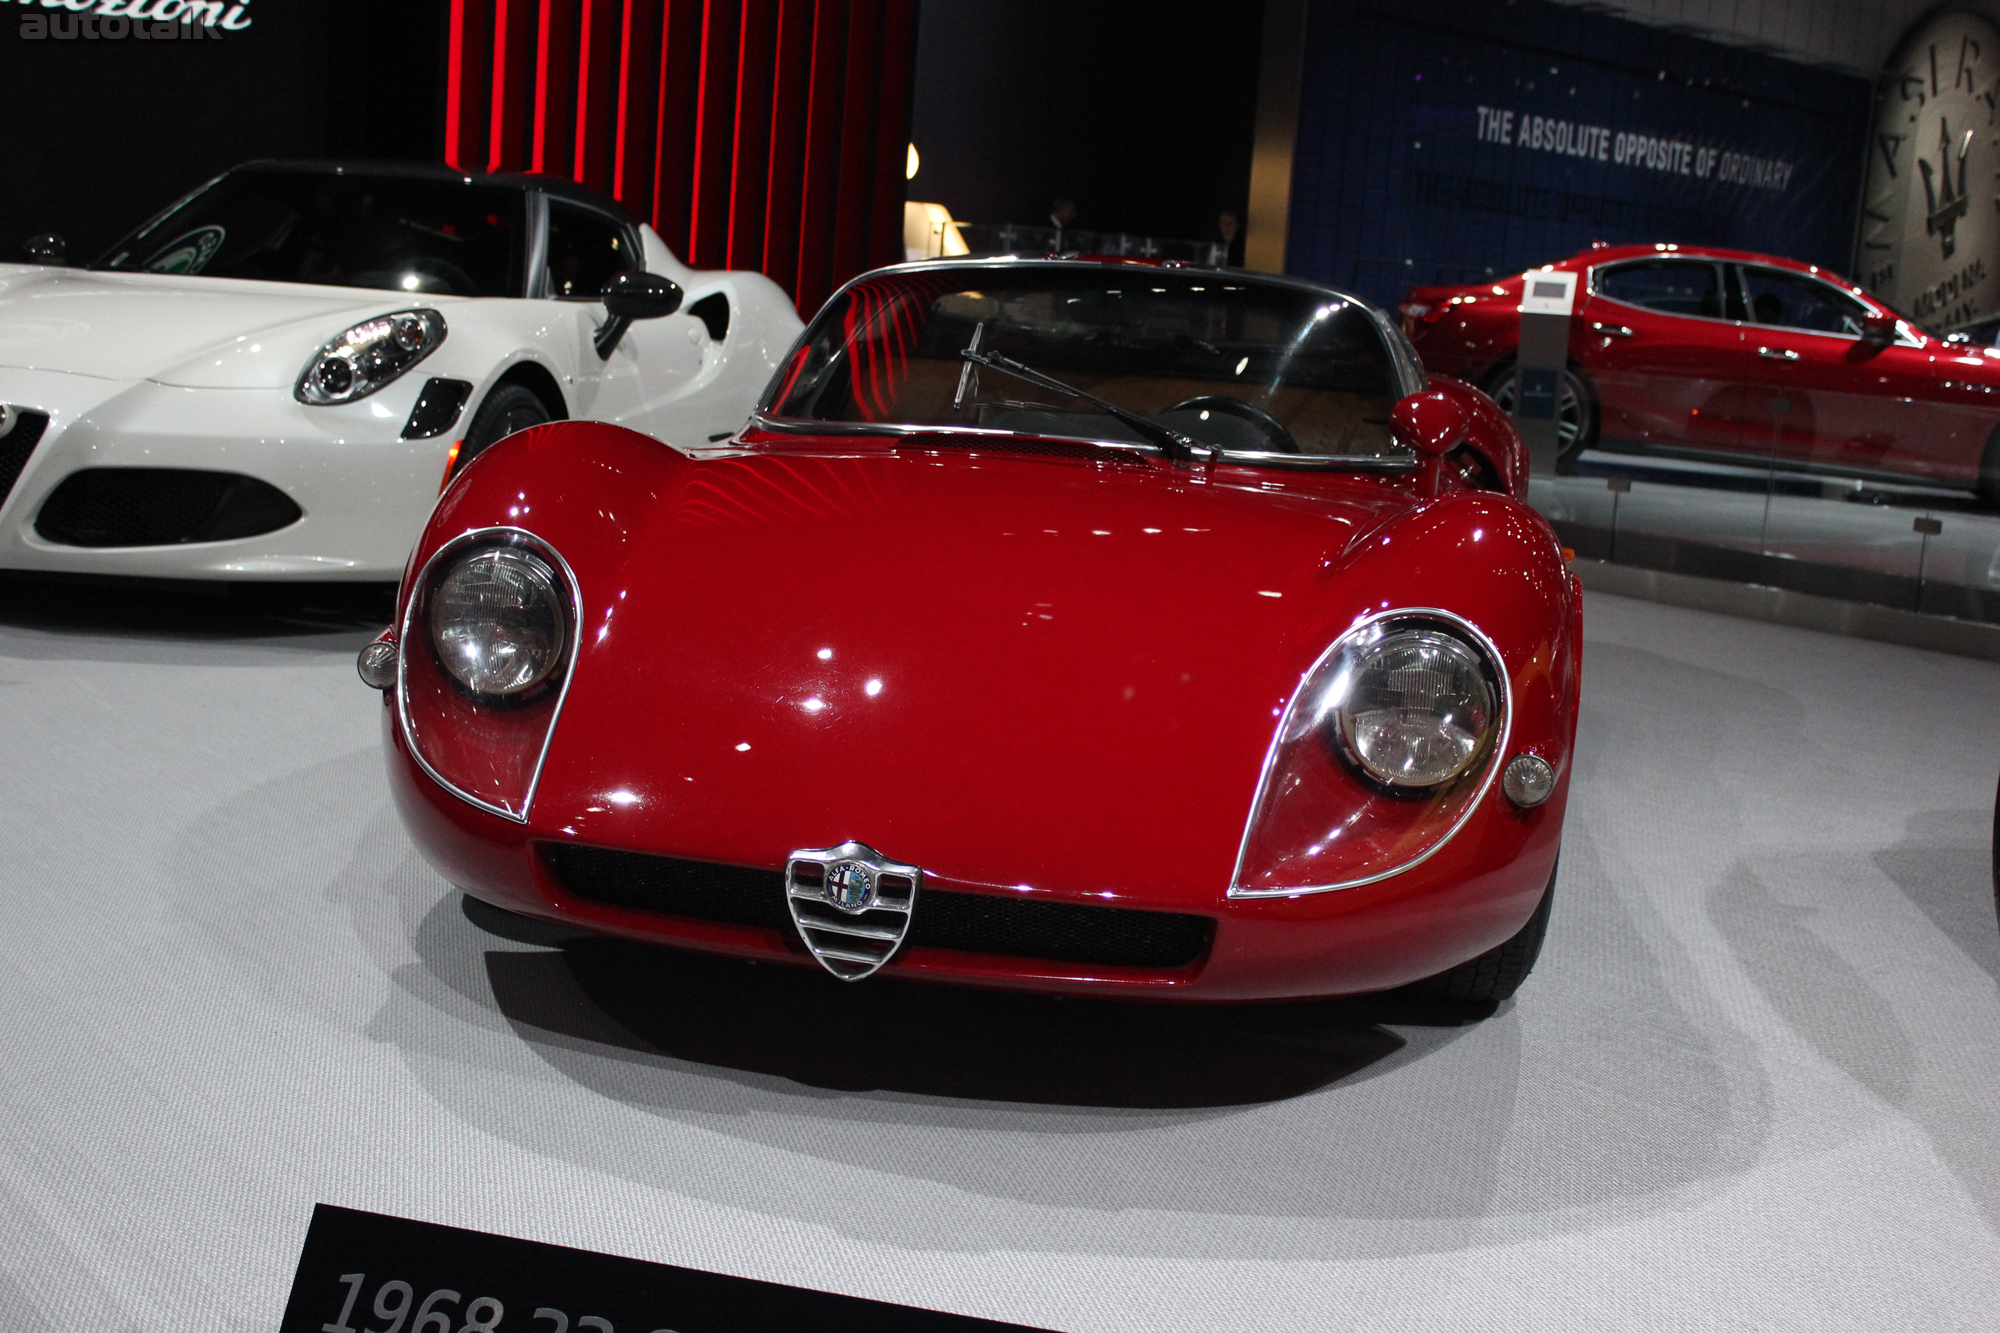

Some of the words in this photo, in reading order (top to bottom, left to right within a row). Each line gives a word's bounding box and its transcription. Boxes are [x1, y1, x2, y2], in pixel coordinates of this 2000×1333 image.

[1477, 106, 1514, 144] THE
[1517, 114, 1611, 161] ABSOLUTE
[1614, 131, 1694, 176] OPPOSITE
[1694, 147, 1719, 178] OF
[1718, 151, 1795, 191] ORDINARY
[321, 1273, 504, 1333] 1968
